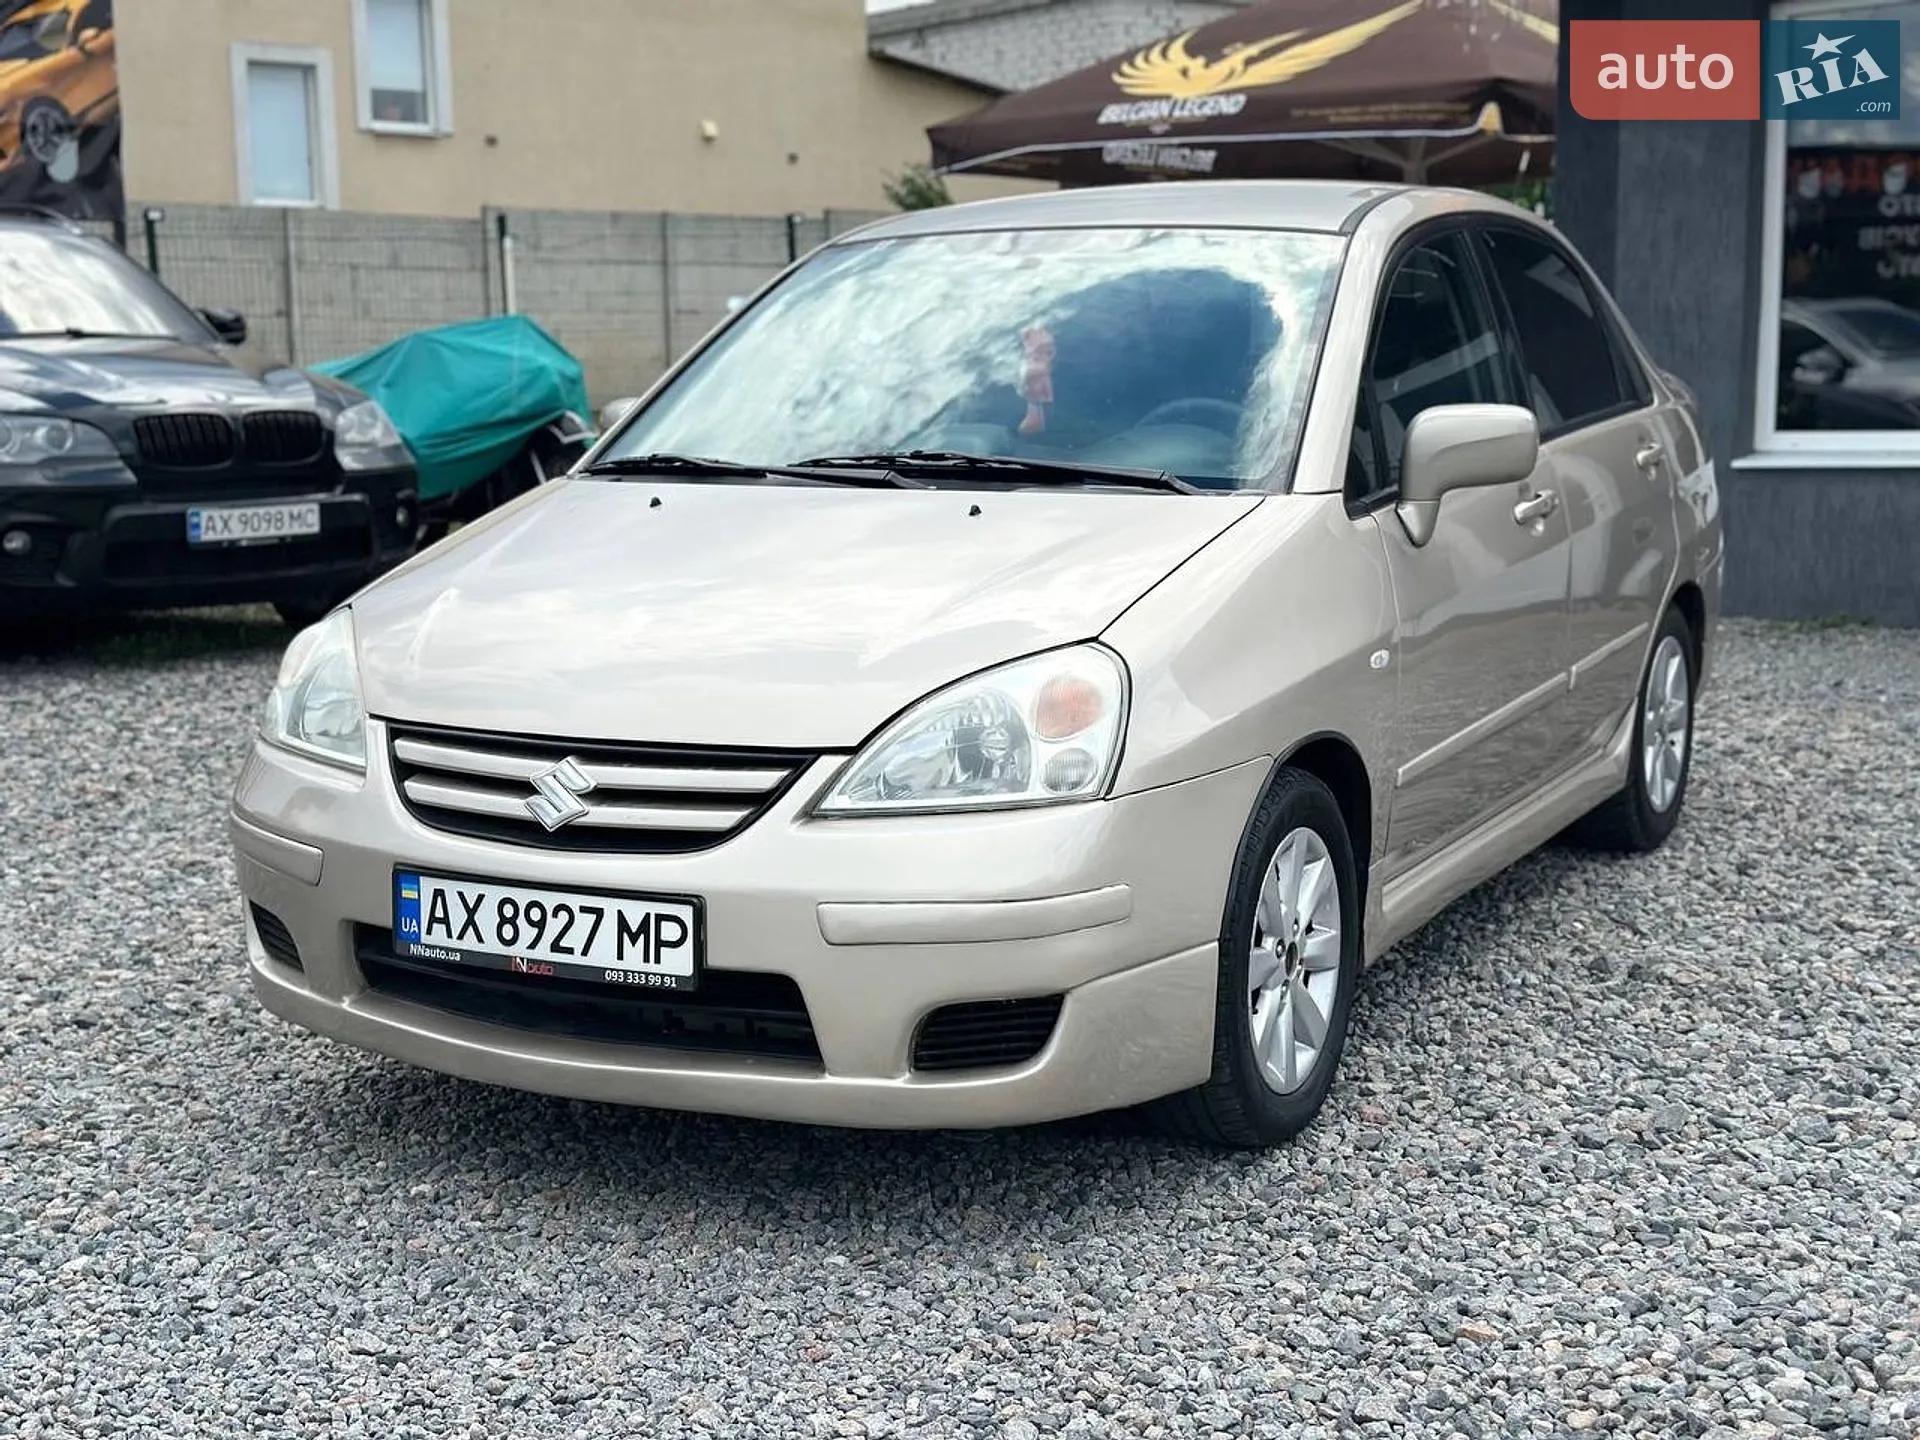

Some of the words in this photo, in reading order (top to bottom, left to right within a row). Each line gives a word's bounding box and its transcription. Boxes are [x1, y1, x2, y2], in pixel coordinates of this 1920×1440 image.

[204, 514, 232, 536] AX
[238, 511, 285, 533] 9098
[289, 508, 315, 530] MC
[401, 916, 419, 934] UA
[425, 887, 486, 944] AX
[496, 896, 605, 957] 8927
[616, 908, 689, 965] MP
[409, 943, 461, 962] NNauto.ua
[604, 969, 624, 982] 093
[626, 971, 646, 984] 333
[663, 976, 677, 988] 91
